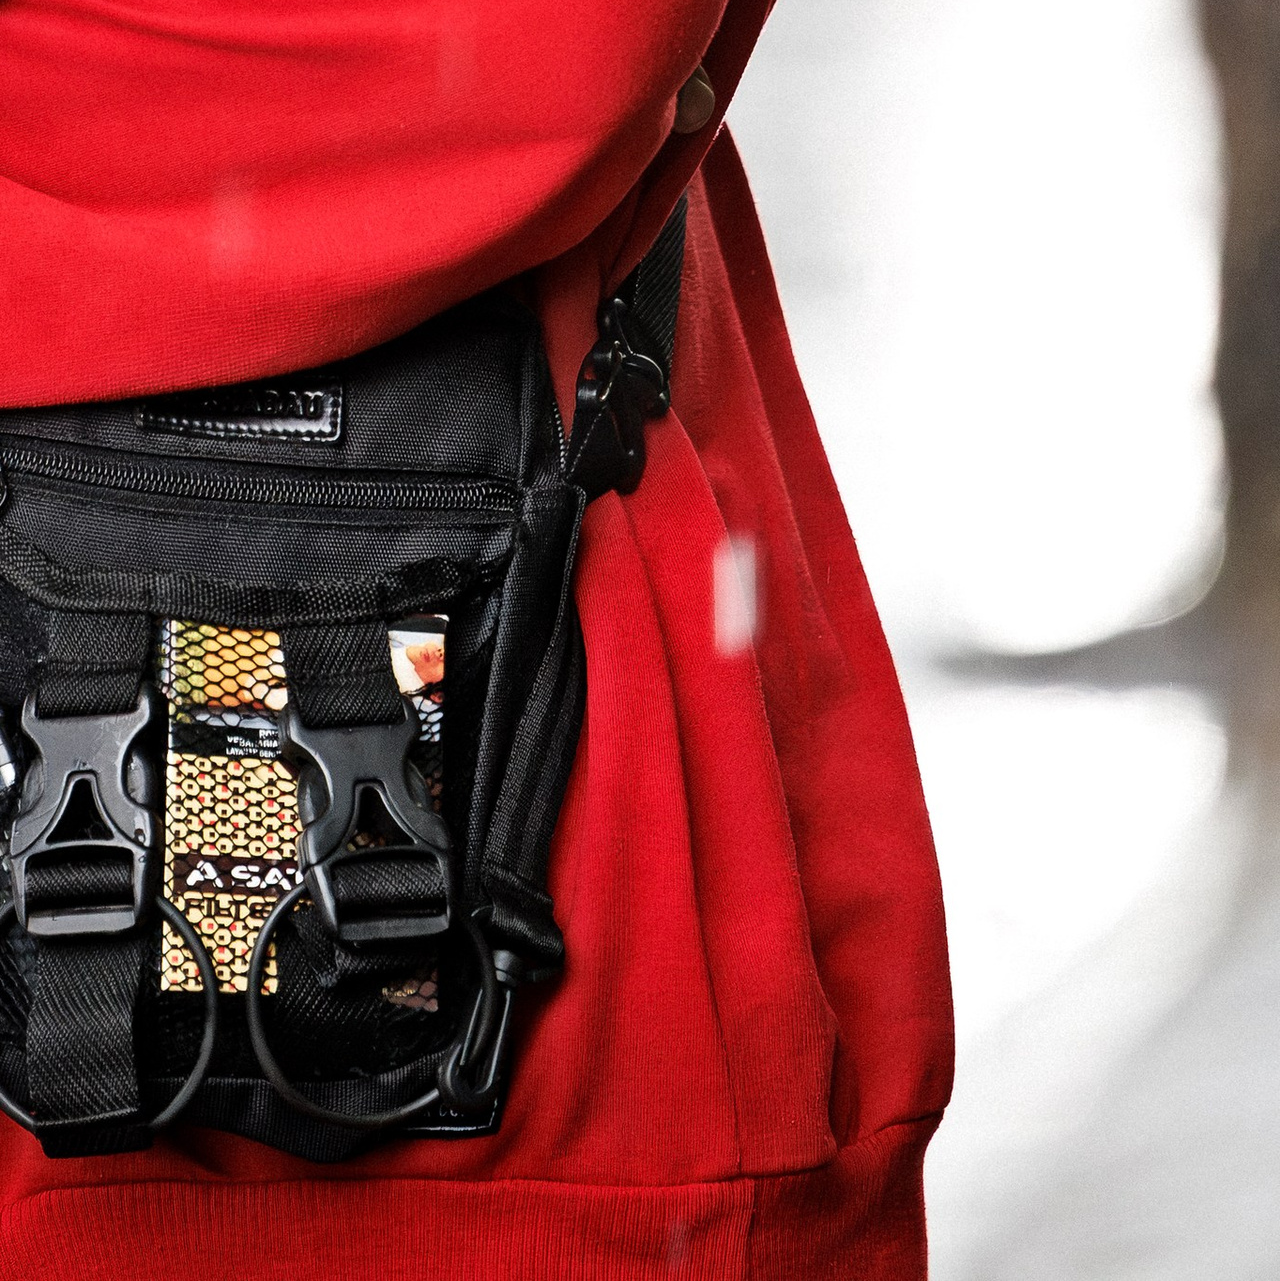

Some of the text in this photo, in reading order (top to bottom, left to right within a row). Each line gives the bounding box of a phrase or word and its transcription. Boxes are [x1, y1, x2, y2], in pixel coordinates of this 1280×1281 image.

[186, 860, 304, 891] A SAT
[185, 898, 273, 921] FILTE
